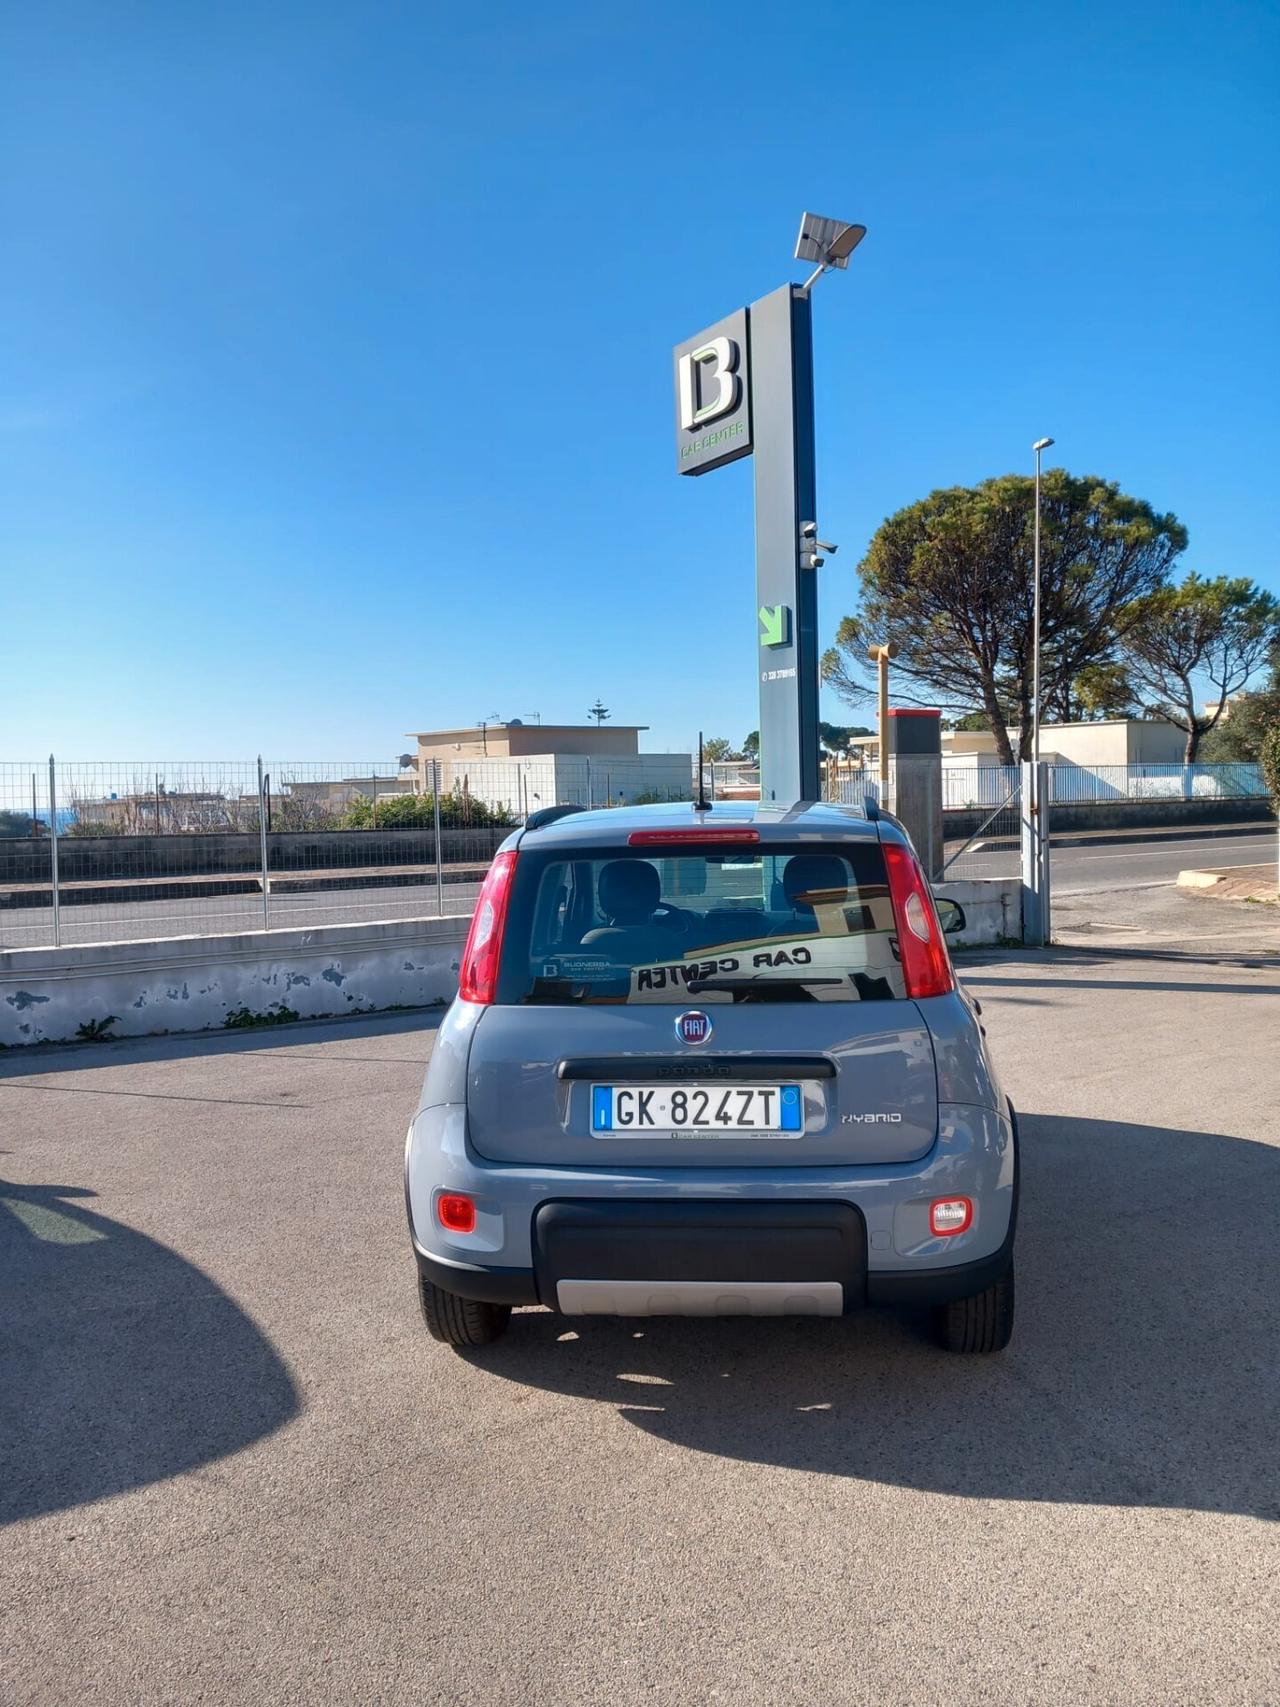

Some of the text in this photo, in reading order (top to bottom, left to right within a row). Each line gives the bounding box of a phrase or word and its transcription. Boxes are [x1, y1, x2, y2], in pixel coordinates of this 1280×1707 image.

[681, 421, 744, 459] CAR CENTER
[684, 1019, 705, 1036] FIAT
[616, 1090, 656, 1126] GK
[670, 1090, 776, 1126] 824ZT
[841, 1113, 902, 1124] HYBRID
